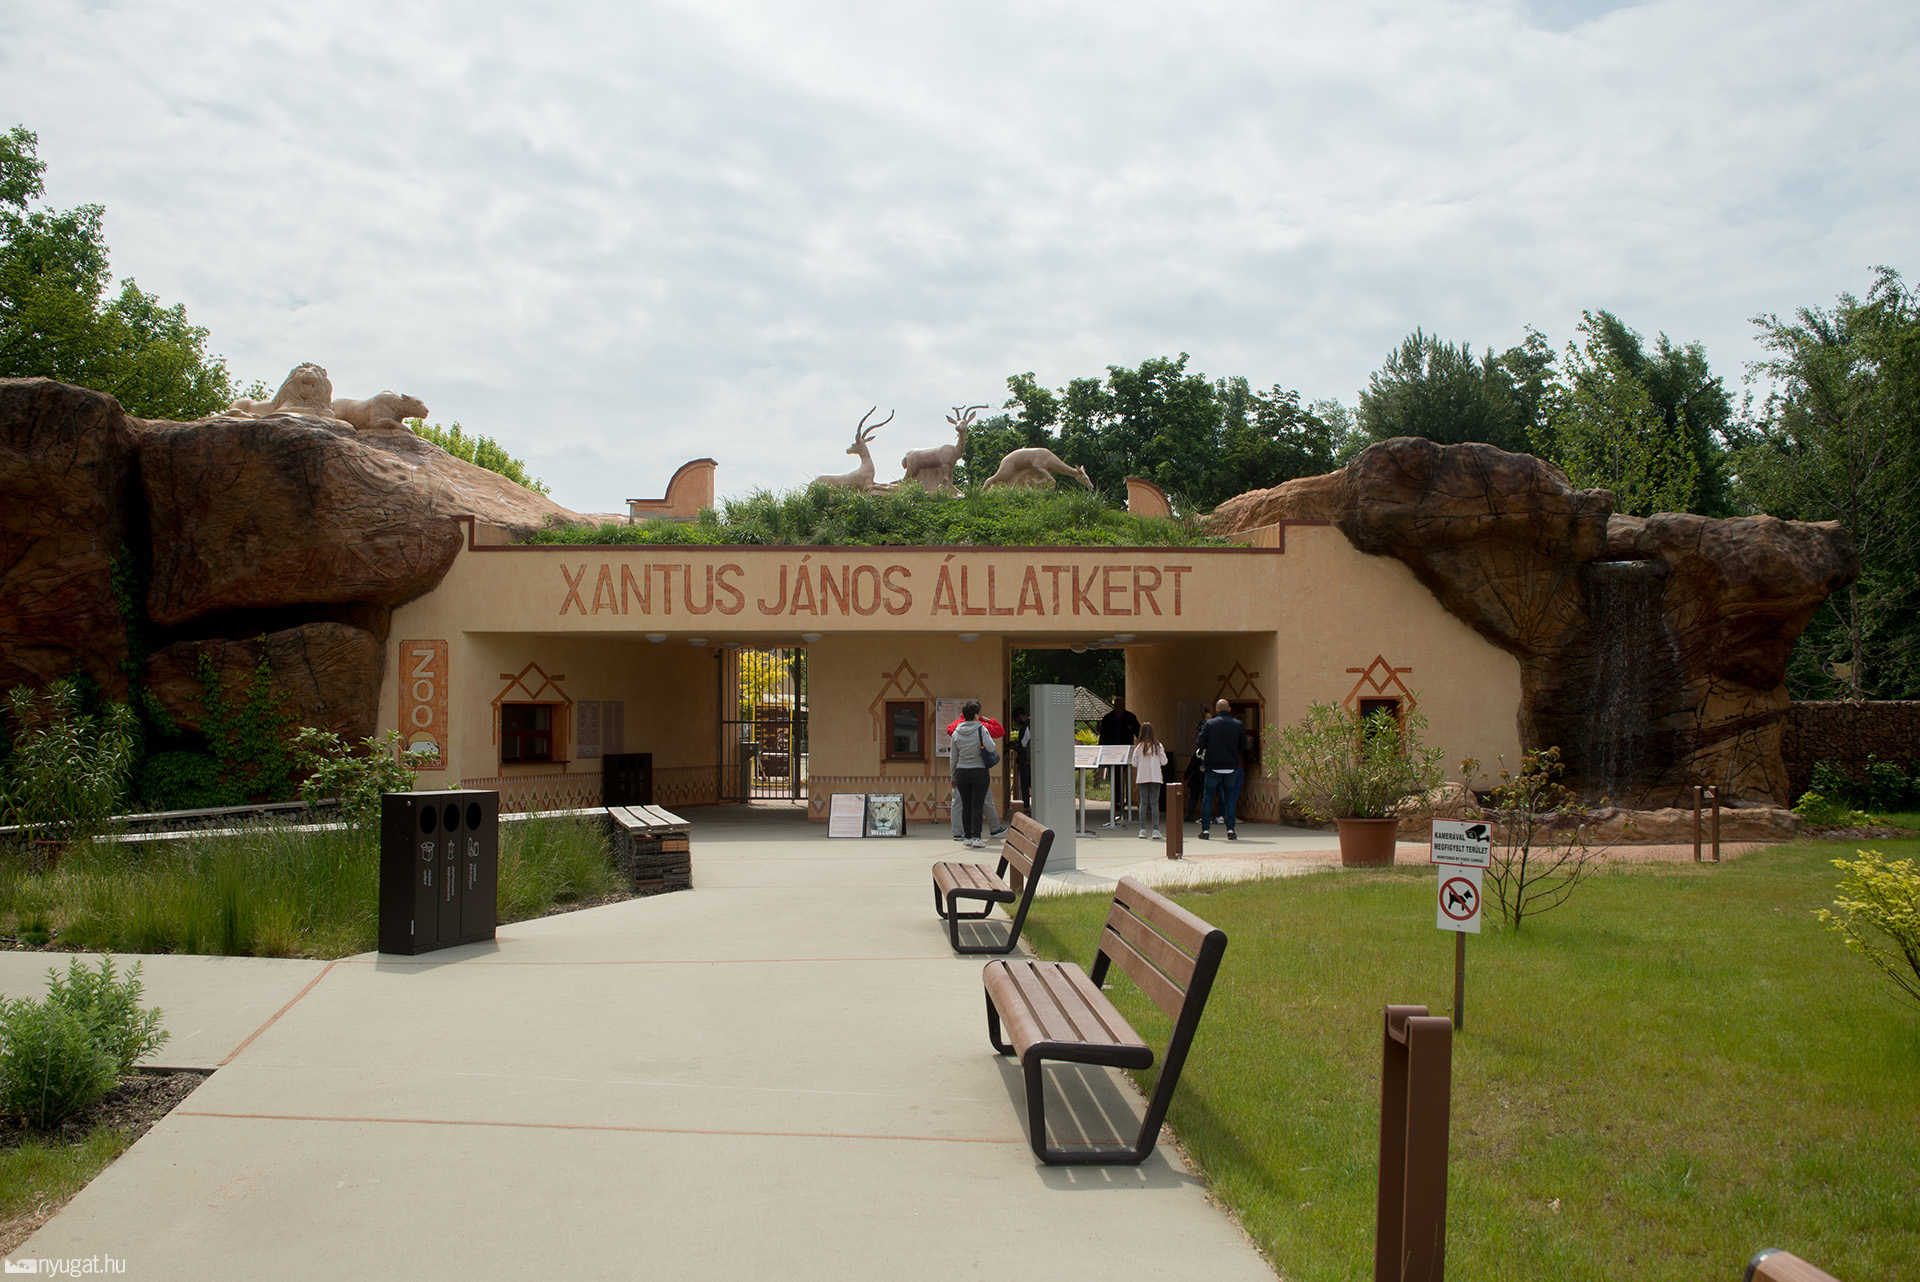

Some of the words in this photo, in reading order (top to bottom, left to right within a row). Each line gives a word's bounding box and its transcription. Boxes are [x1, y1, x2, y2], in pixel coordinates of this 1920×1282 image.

[559, 563, 745, 615] XANTUS
[757, 554, 913, 616] JÁNOS
[930, 554, 1193, 616] ÁLLATKERT
[411, 649, 435, 728] ZOO
[1434, 843, 1464, 852] MEGFIGYELT
[1466, 845, 1488, 854] TERÜLET
[1435, 832, 1465, 841] KAMERÁVAL
